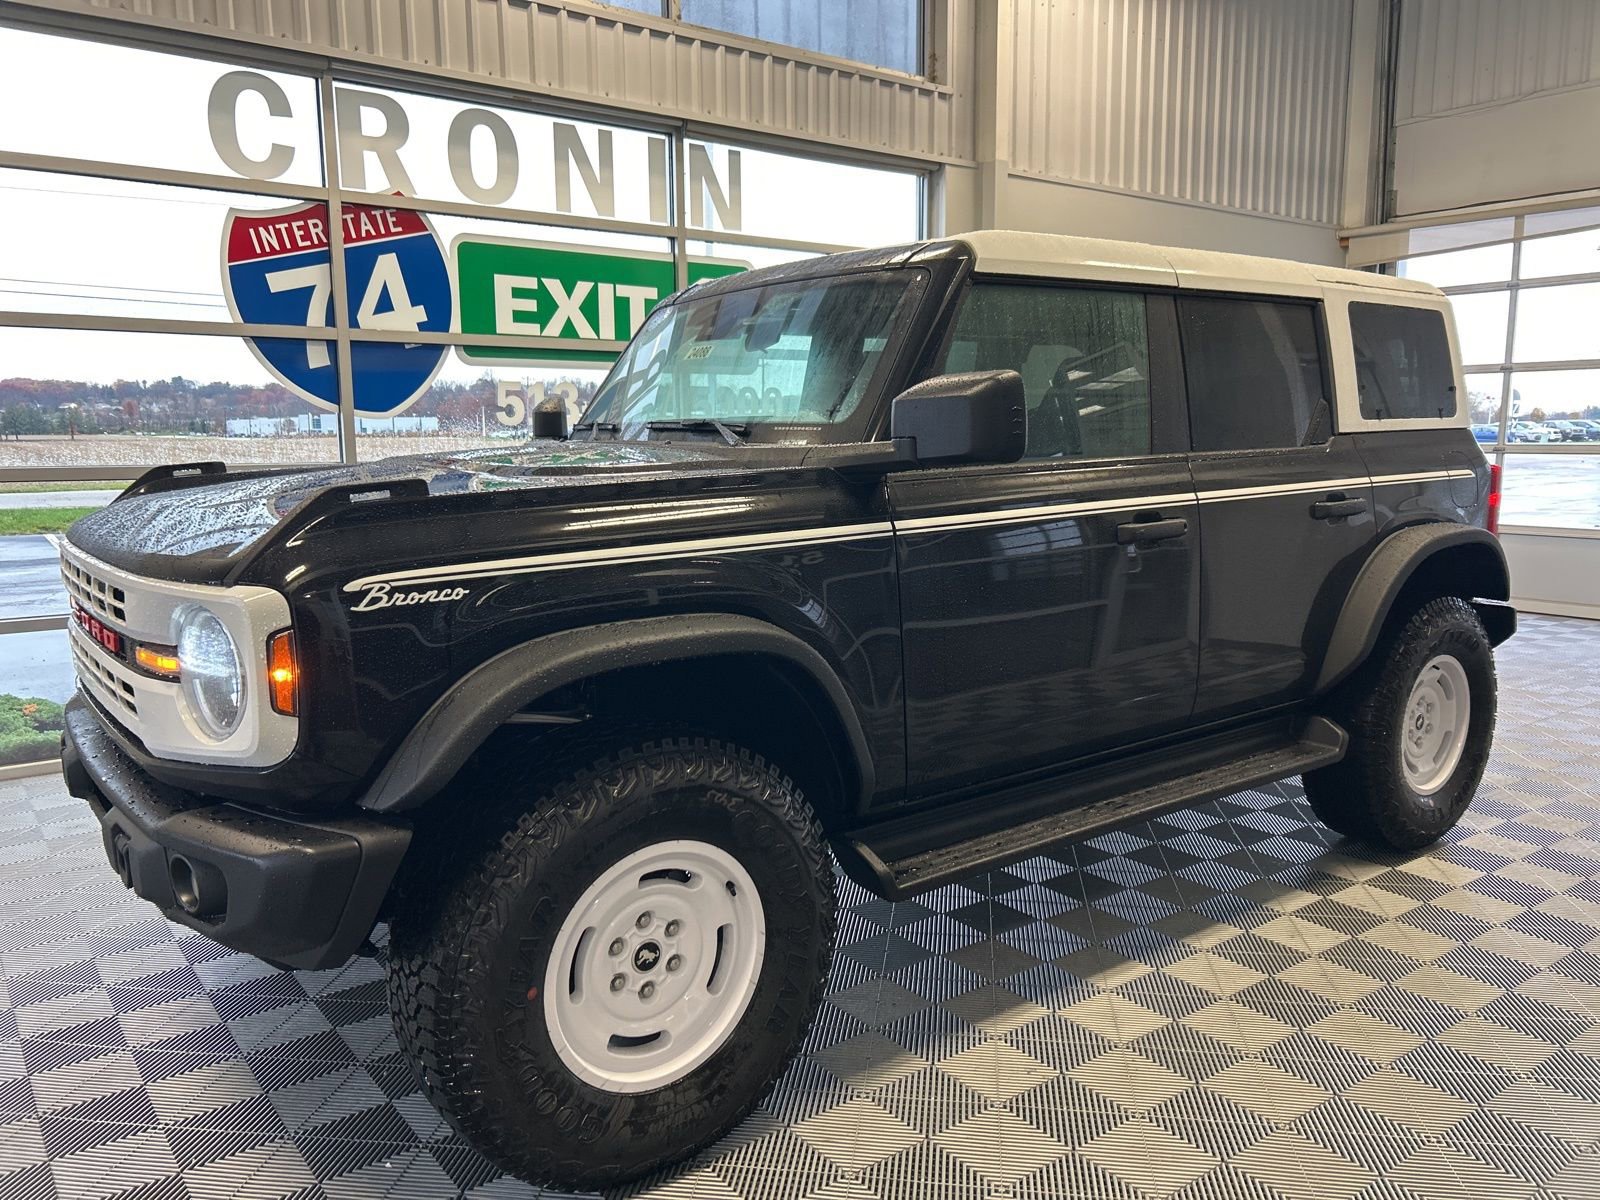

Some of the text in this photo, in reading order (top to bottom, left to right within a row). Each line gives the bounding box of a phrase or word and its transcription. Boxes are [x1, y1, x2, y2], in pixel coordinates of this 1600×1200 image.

[208, 71, 742, 231] CRONIN
[248, 208, 403, 256] INTERTATE
[265, 252, 428, 370] 74
[493, 273, 658, 339] EXIT
[350, 582, 470, 612] Bronco
